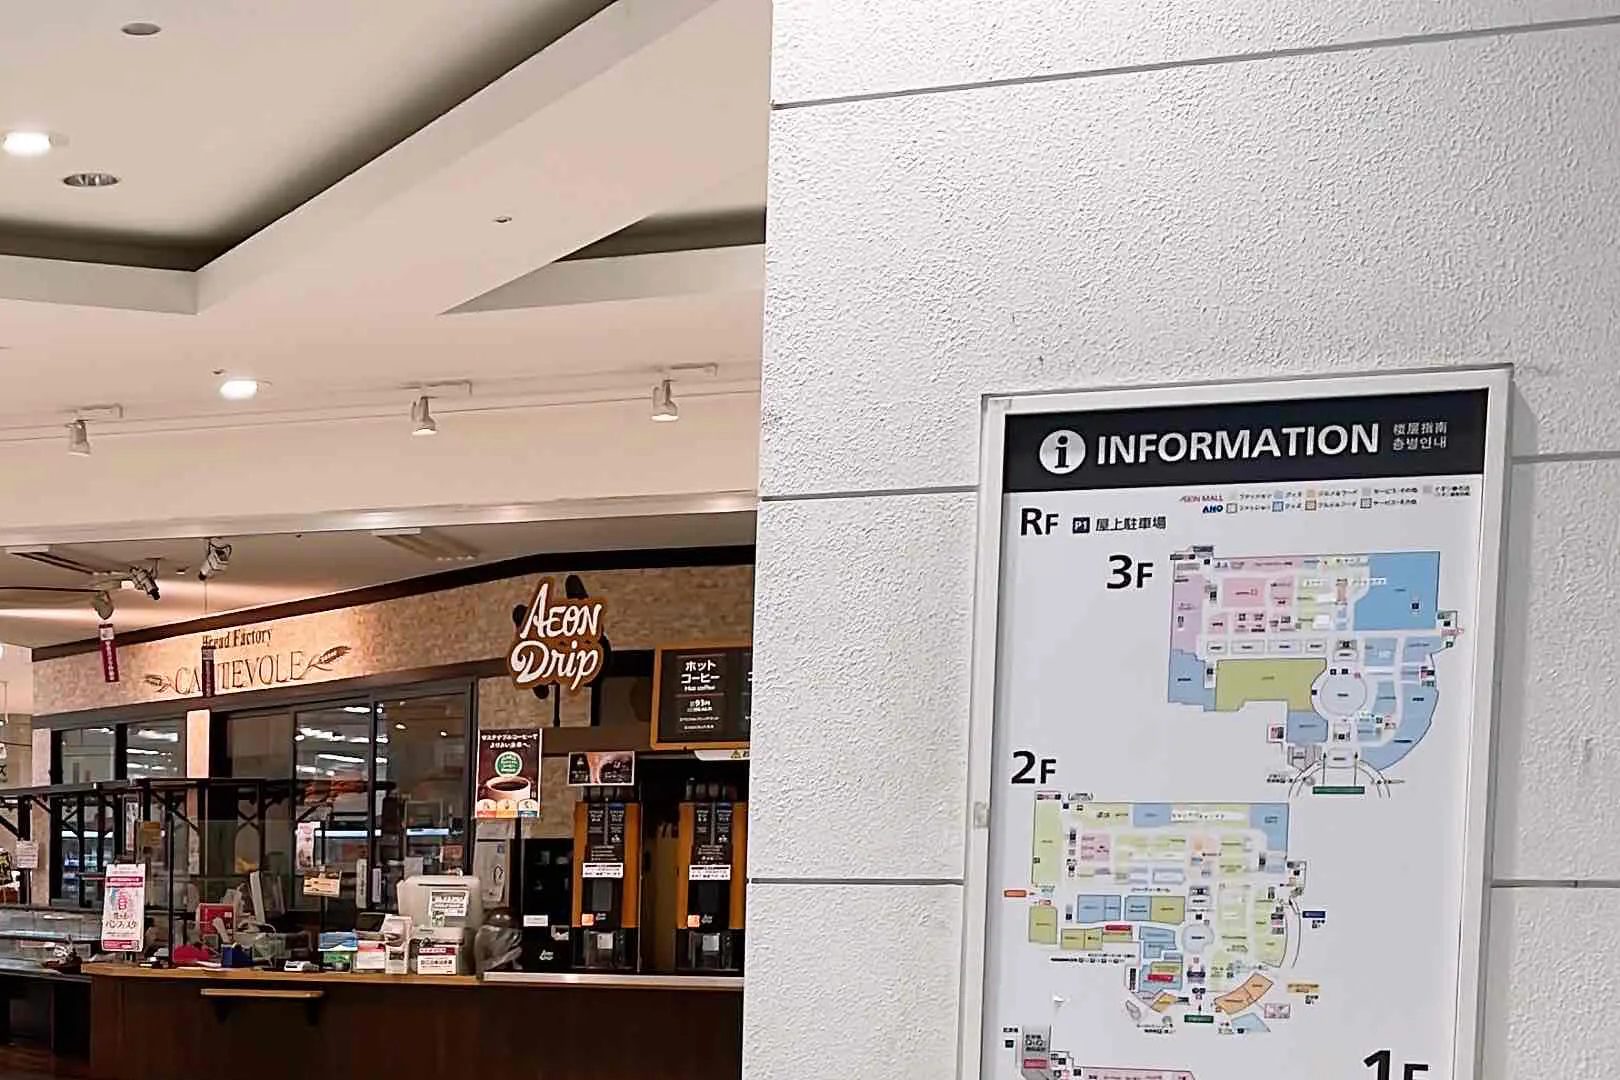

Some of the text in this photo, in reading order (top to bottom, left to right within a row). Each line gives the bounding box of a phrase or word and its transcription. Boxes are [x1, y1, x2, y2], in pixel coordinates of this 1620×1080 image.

[1097, 423, 1379, 465] INFORMATION
[1021, 508, 1059, 536] RF
[1107, 555, 1153, 589] 3F
[233, 628, 272, 647] Factory
[175, 650, 306, 695] CATEVOLE
[511, 640, 598, 690] Drip
[681, 673, 720, 684] コーヒー
[685, 660, 717, 671] ホット
[1011, 750, 1057, 784] 2F
